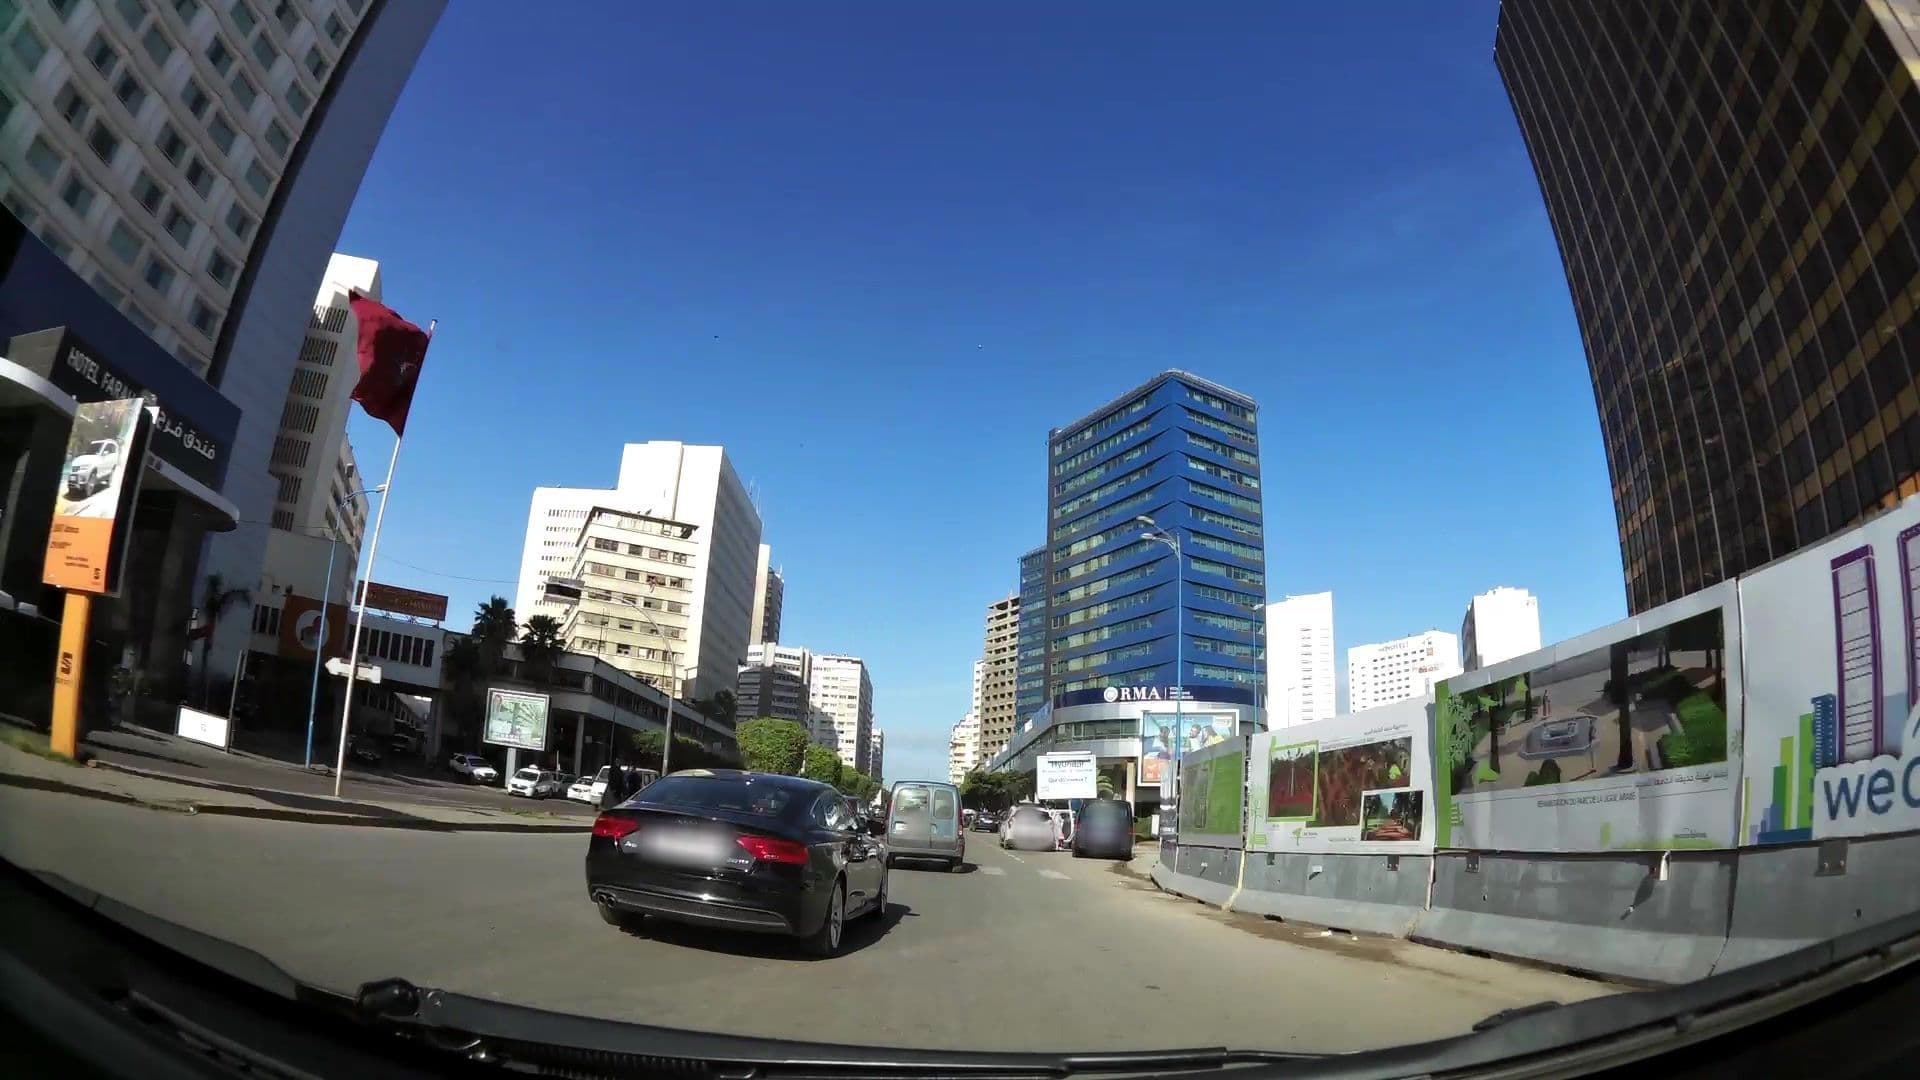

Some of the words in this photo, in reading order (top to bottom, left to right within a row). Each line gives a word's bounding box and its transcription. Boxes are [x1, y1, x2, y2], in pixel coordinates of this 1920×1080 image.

[67, 346, 99, 384] HOTEL
[183, 428, 216, 460] فندق
[1120, 687, 1161, 700] RMA
